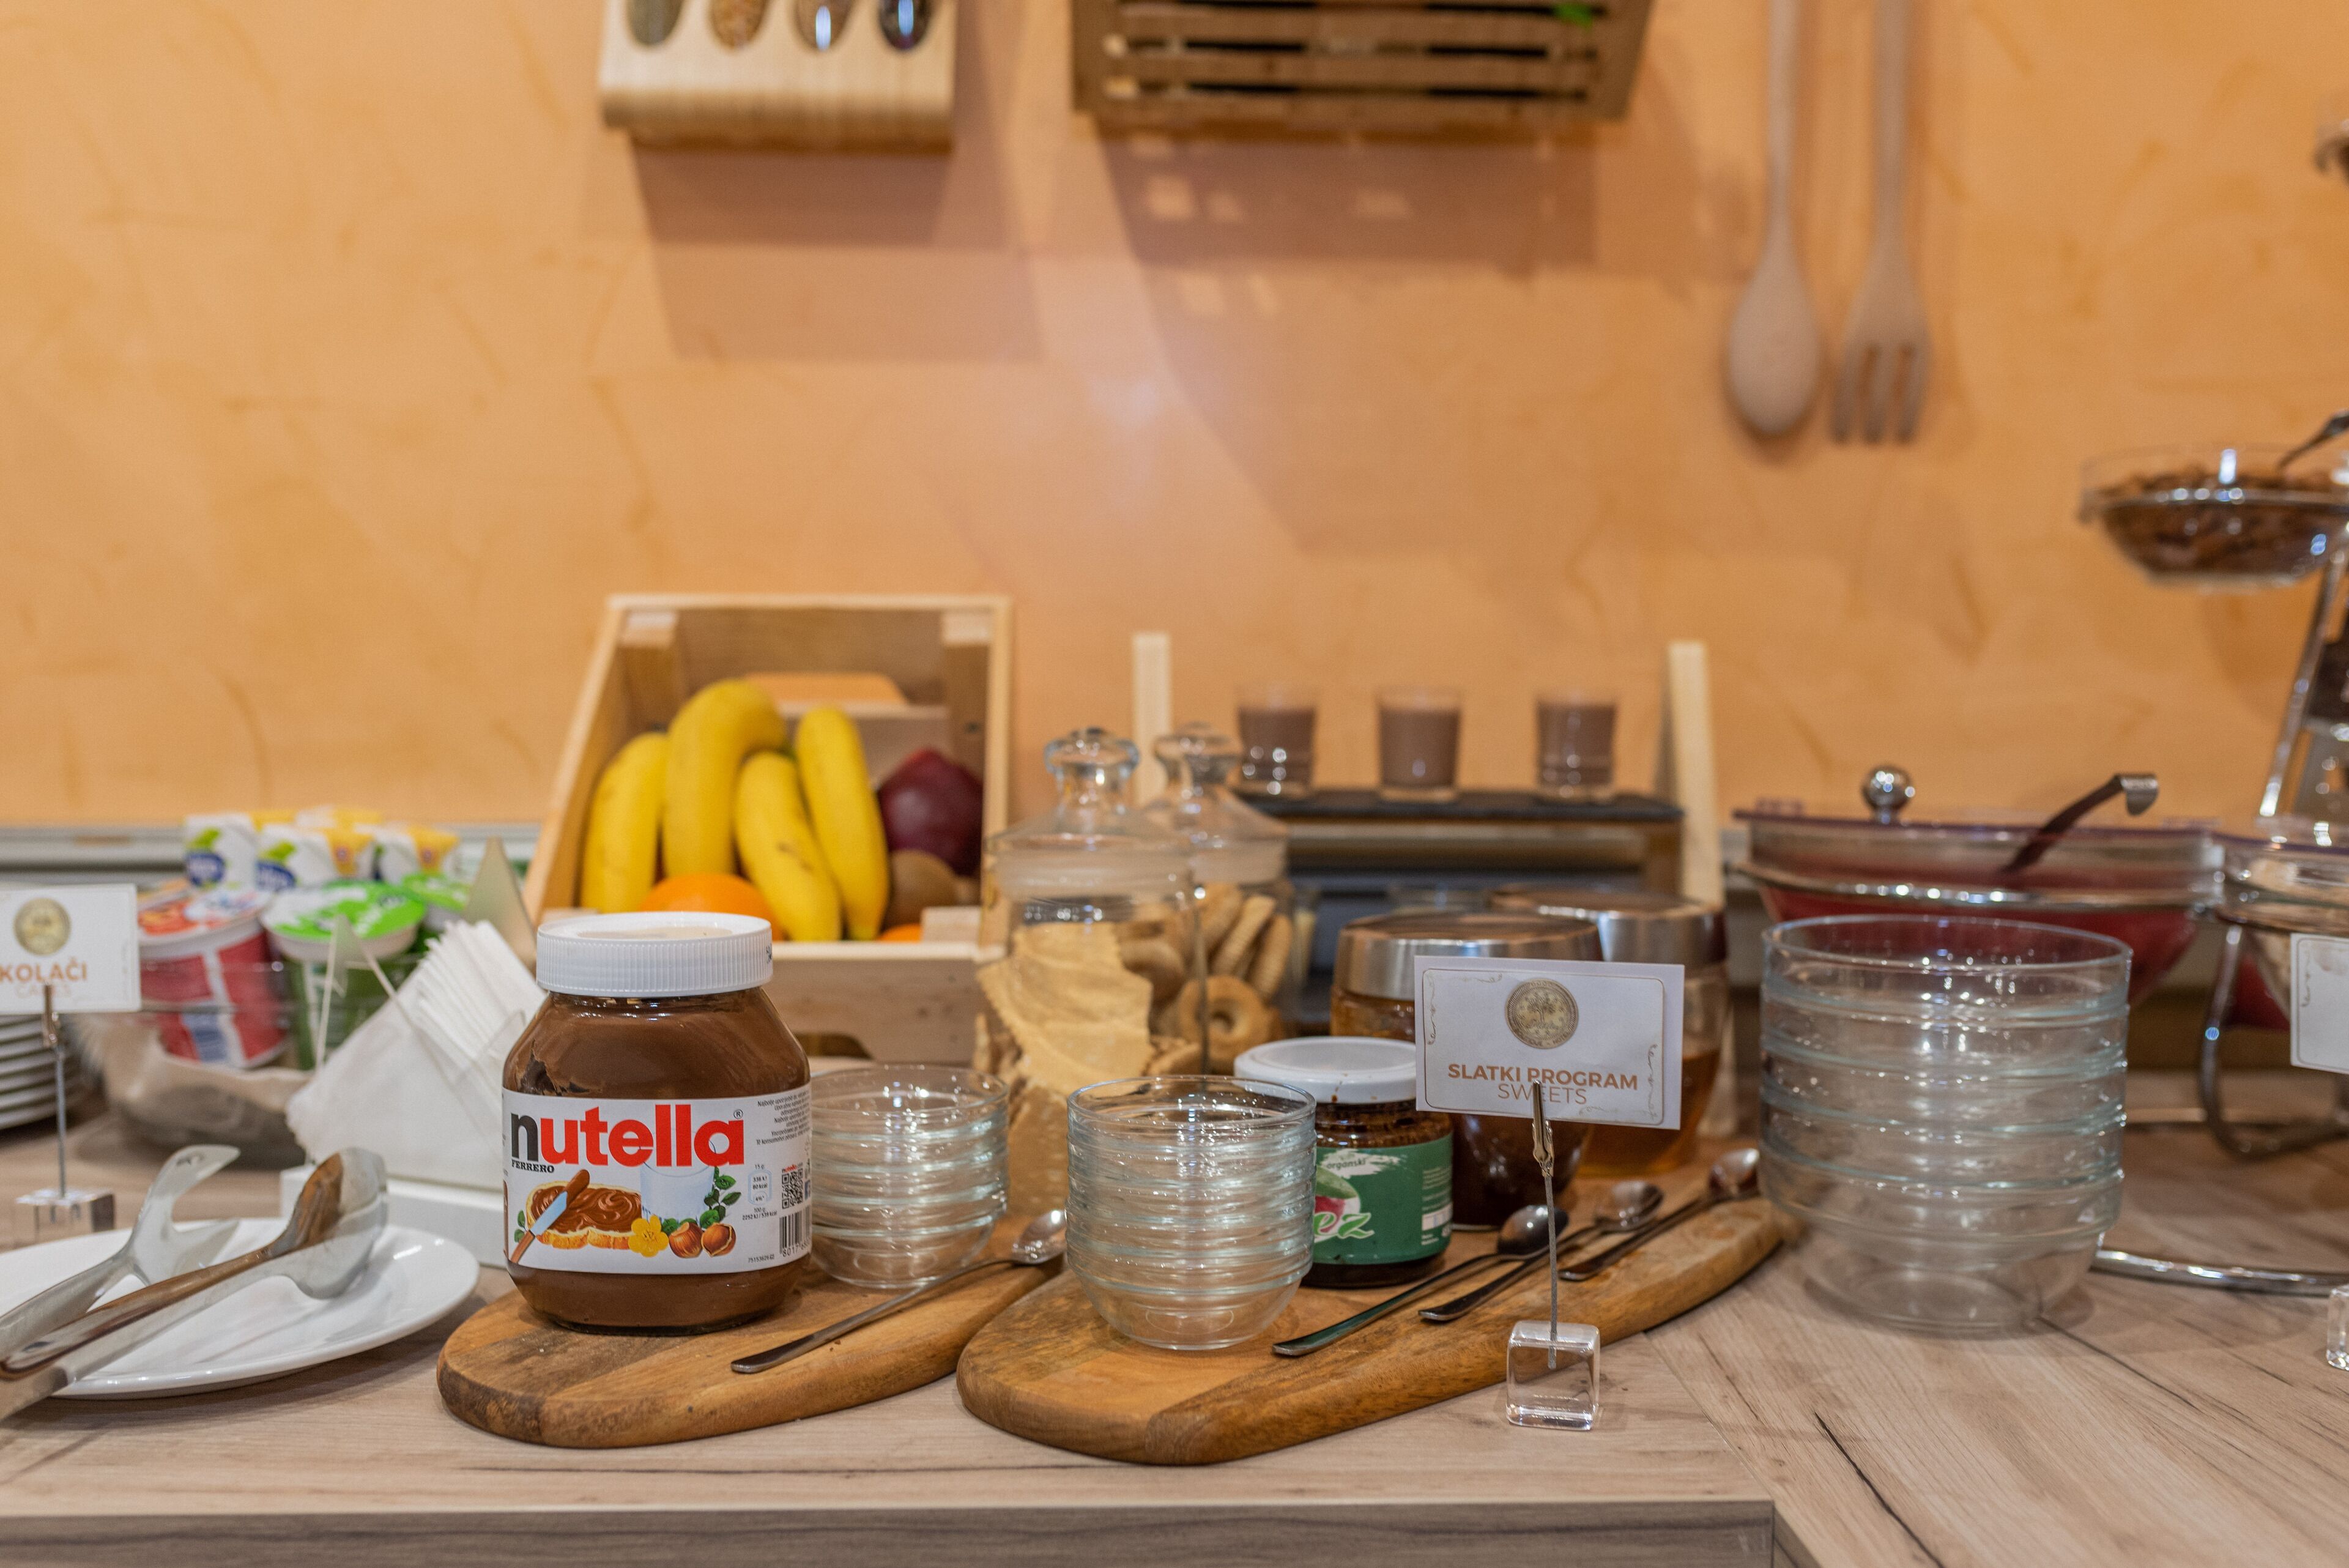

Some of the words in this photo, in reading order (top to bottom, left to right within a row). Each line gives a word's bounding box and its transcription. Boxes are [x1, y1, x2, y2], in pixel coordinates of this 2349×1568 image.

[1448, 1064, 1521, 1082] SLATKI
[1527, 1068, 1638, 1090] PROGRAM
[511, 1104, 744, 1167] nutella
[511, 1159, 555, 1173] FERRERO
